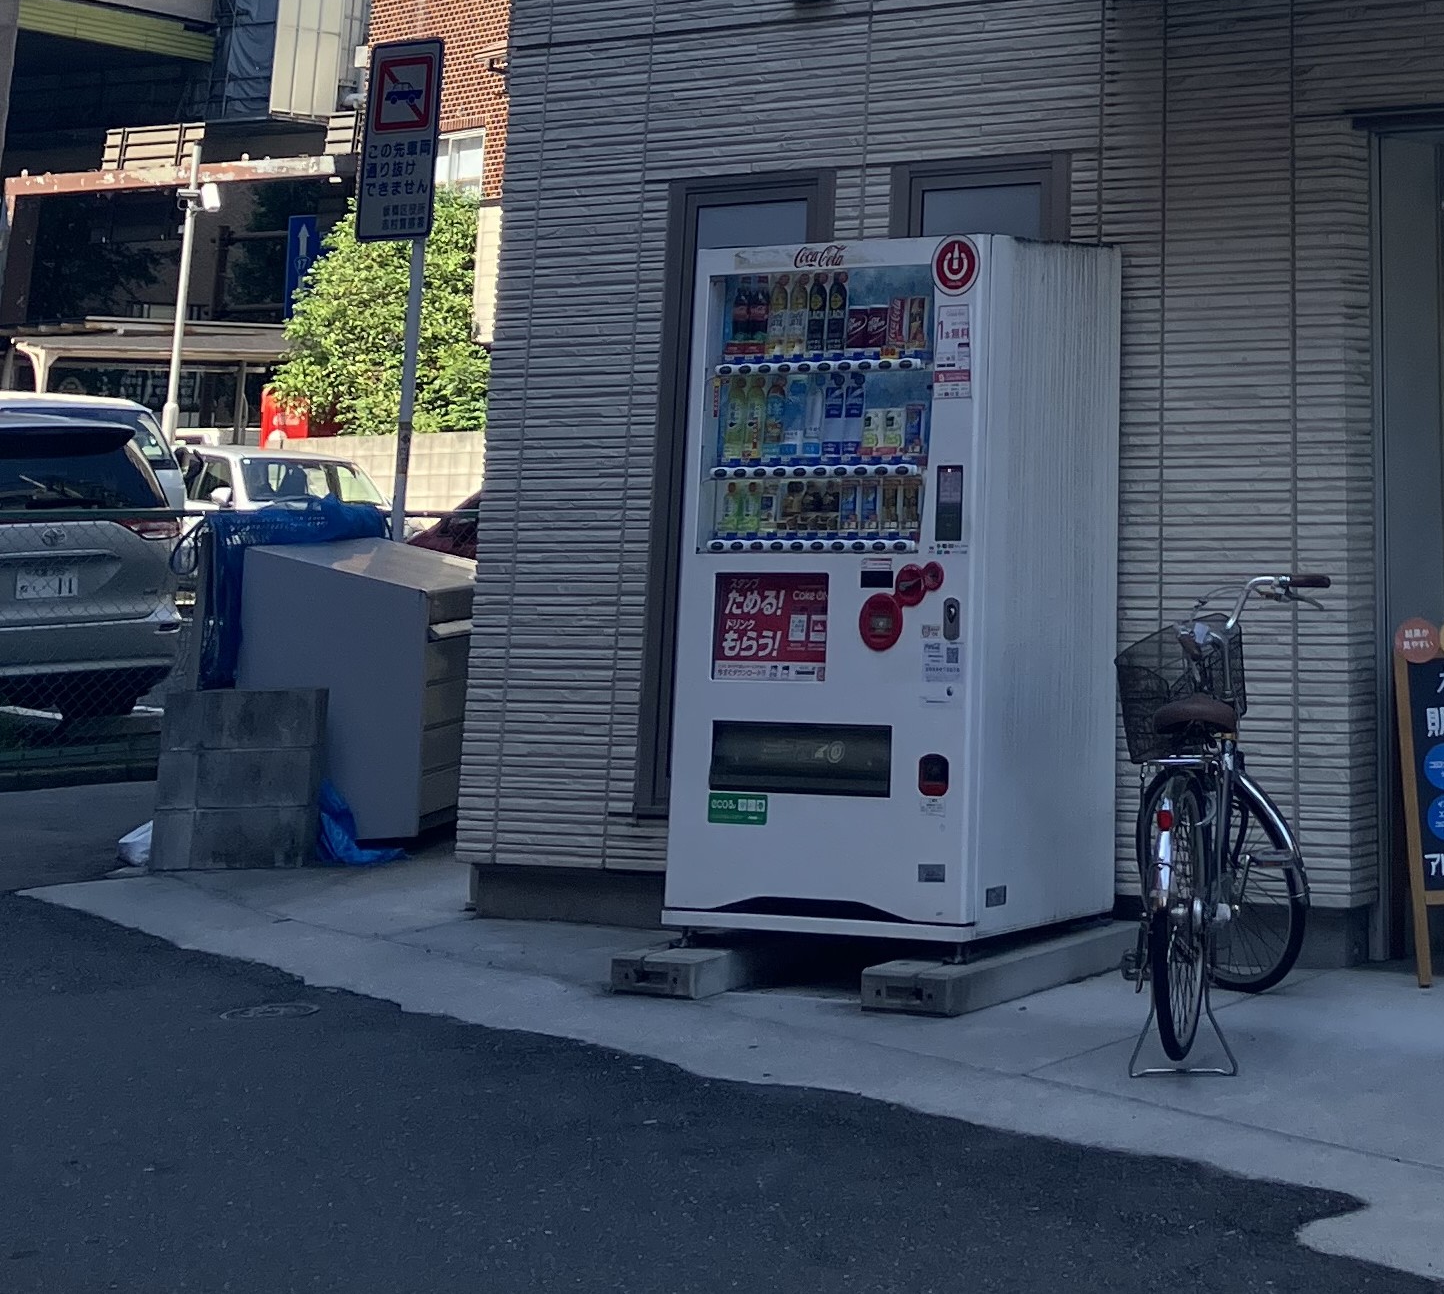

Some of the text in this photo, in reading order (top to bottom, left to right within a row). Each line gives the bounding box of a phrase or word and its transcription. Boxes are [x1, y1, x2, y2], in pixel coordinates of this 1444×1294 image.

[368, 140, 431, 159] この先車両
[366, 160, 416, 179] 通り抜け
[366, 179, 428, 197] できません
[730, 577, 760, 589] スタンプ
[792, 590, 815, 601] Coke
[725, 619, 756, 630] ドリンク
